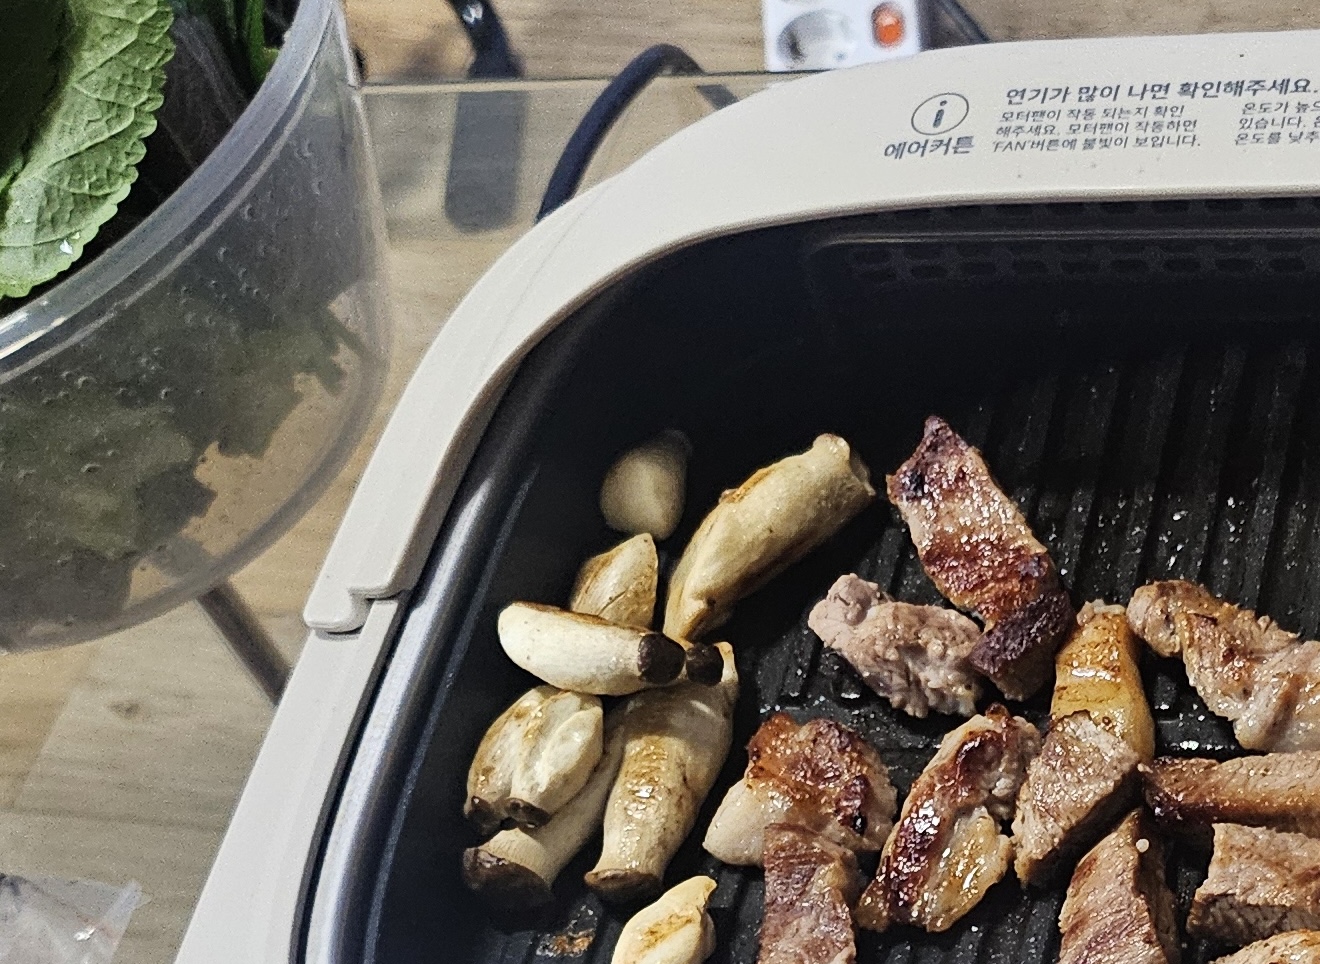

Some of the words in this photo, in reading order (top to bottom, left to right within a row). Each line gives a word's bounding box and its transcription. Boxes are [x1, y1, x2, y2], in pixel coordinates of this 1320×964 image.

[1006, 86, 1071, 105] 연기가
[1077, 84, 1120, 103] 많이
[1127, 82, 1171, 100] 나면
[1177, 78, 1318, 99] 확인해주세요.
[1000, 109, 1061, 122] 모터팬이
[1066, 108, 1096, 121] 작동
[1102, 106, 1148, 119] 되는지
[1154, 105, 1184, 118] 확인
[1242, 101, 1289, 115] 온도가
[996, 124, 1061, 138] 해주세요.
[1066, 121, 1129, 135] 모터팬이
[1135, 119, 1198, 133] 작동하면
[1239, 116, 1306, 130] 있습니다.
[1082, 137, 1129, 150] 불빛이
[1132, 134, 1201, 148] 보입니다.
[1235, 131, 1281, 146] 온도를
[883, 135, 975, 160] 에어커튼
